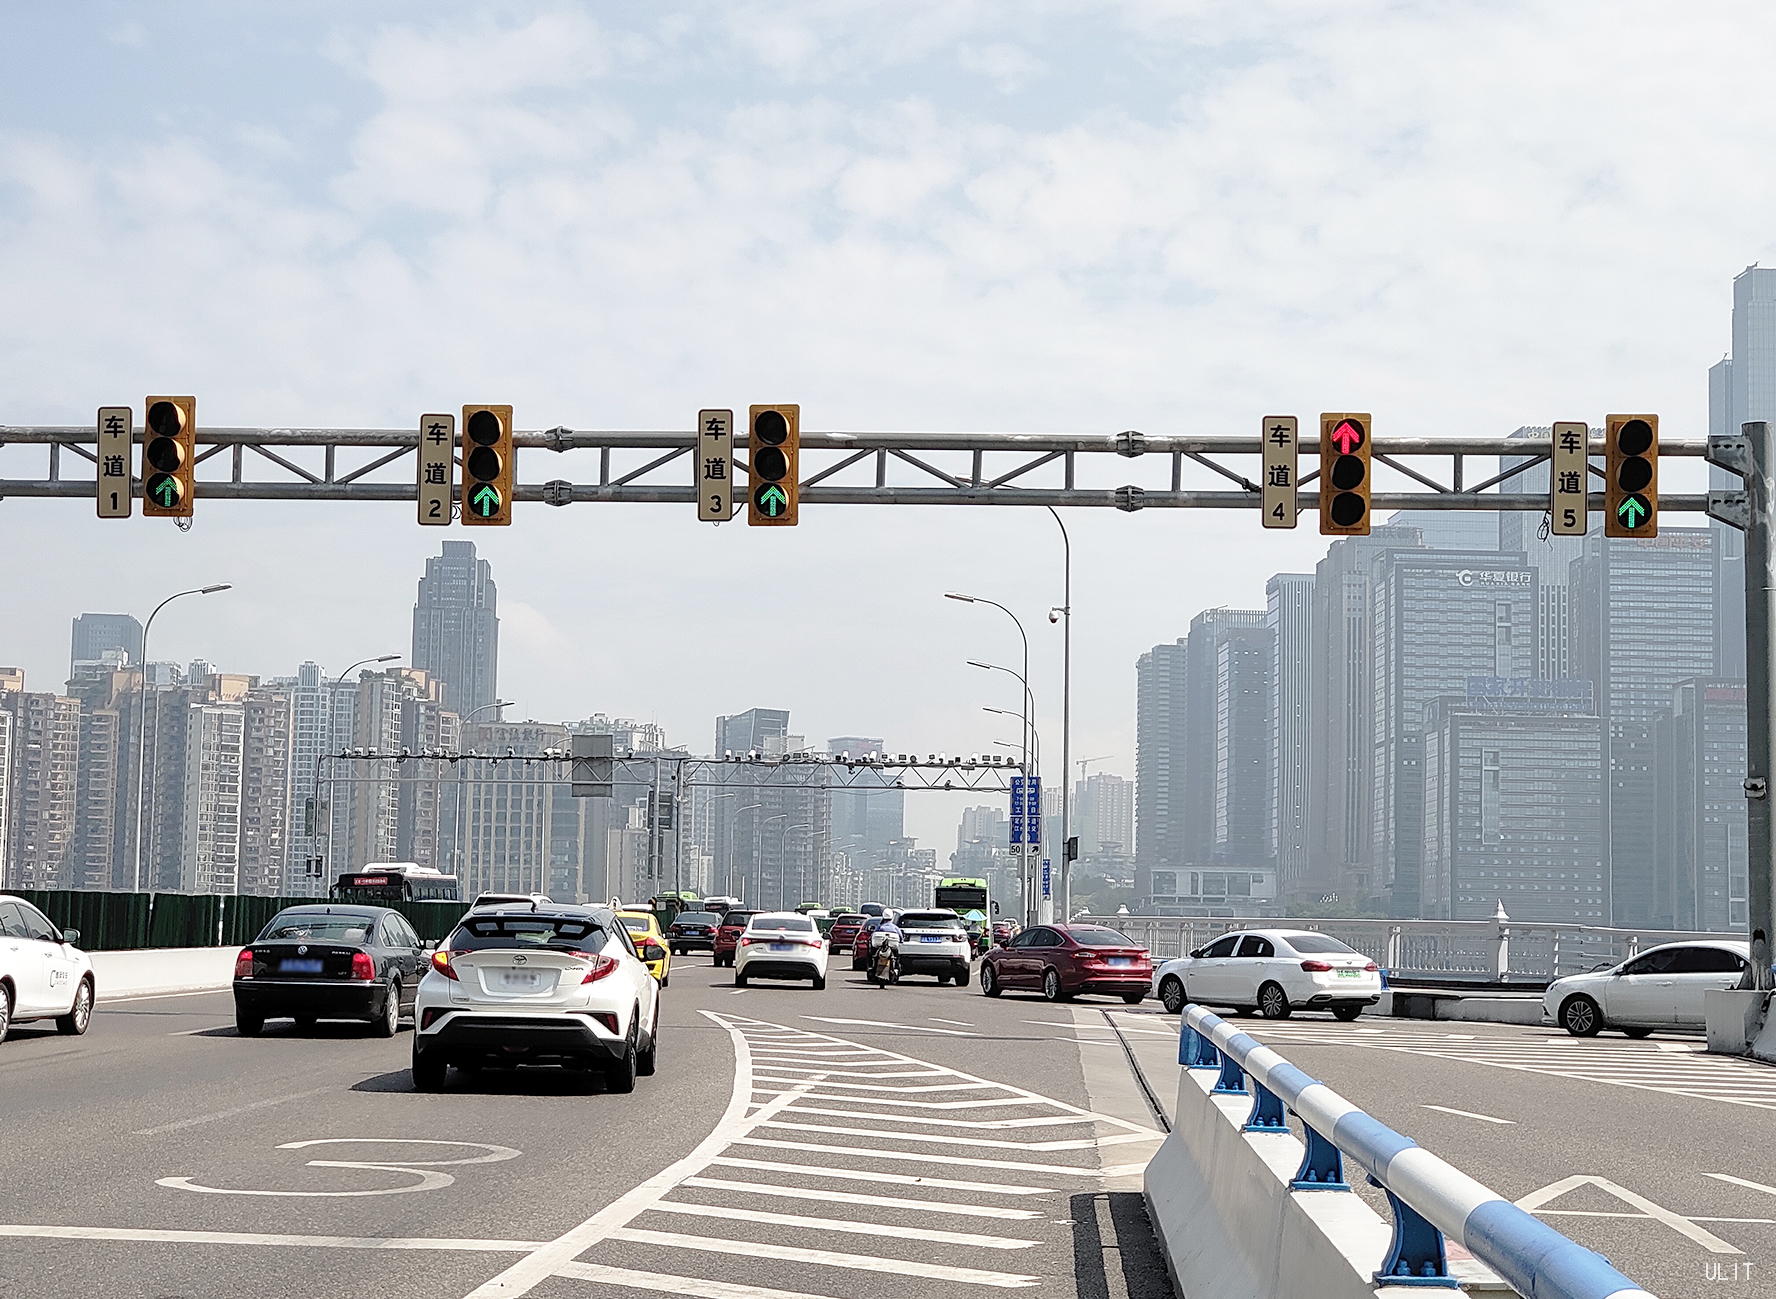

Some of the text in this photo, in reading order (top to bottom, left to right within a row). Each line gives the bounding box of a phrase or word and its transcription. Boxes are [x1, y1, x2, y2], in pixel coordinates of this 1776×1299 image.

[103, 414, 126, 511] 车道1
[424, 422, 448, 518] 车道2
[703, 417, 727, 513] 车道3
[1268, 423, 1292, 521] 车道4
[1558, 430, 1582, 528] 车道5
[1479, 570, 1532, 582] 华夏银行
